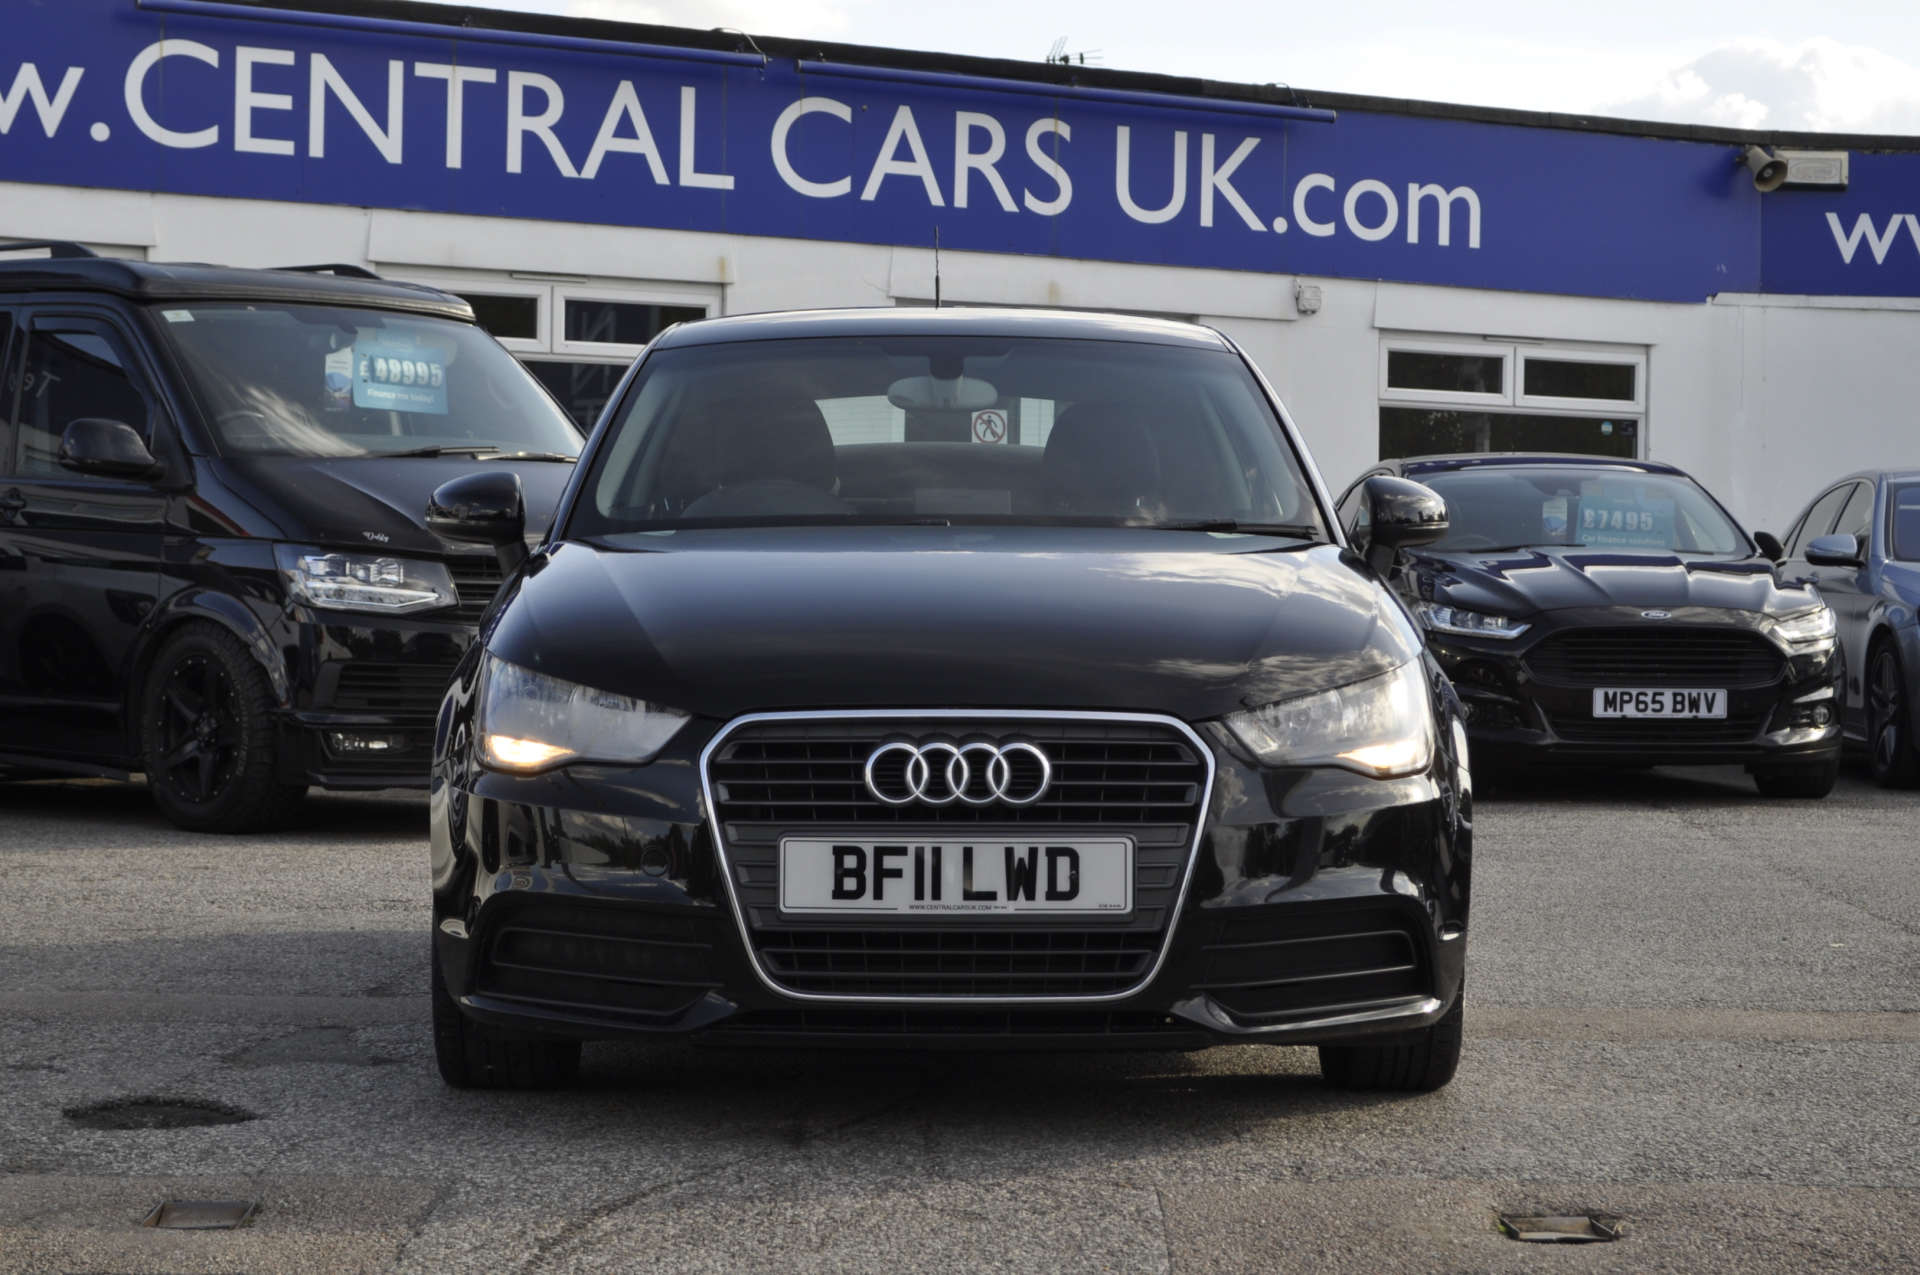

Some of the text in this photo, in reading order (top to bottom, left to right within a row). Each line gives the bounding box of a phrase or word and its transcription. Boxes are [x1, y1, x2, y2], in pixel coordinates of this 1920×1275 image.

[770, 96, 1074, 217] CARS
[1115, 125, 1482, 249] UK.com
[1583, 508, 1654, 531] £7495
[1603, 691, 1716, 713] MP65 BWV
[831, 845, 1081, 901] BF11 LWD
